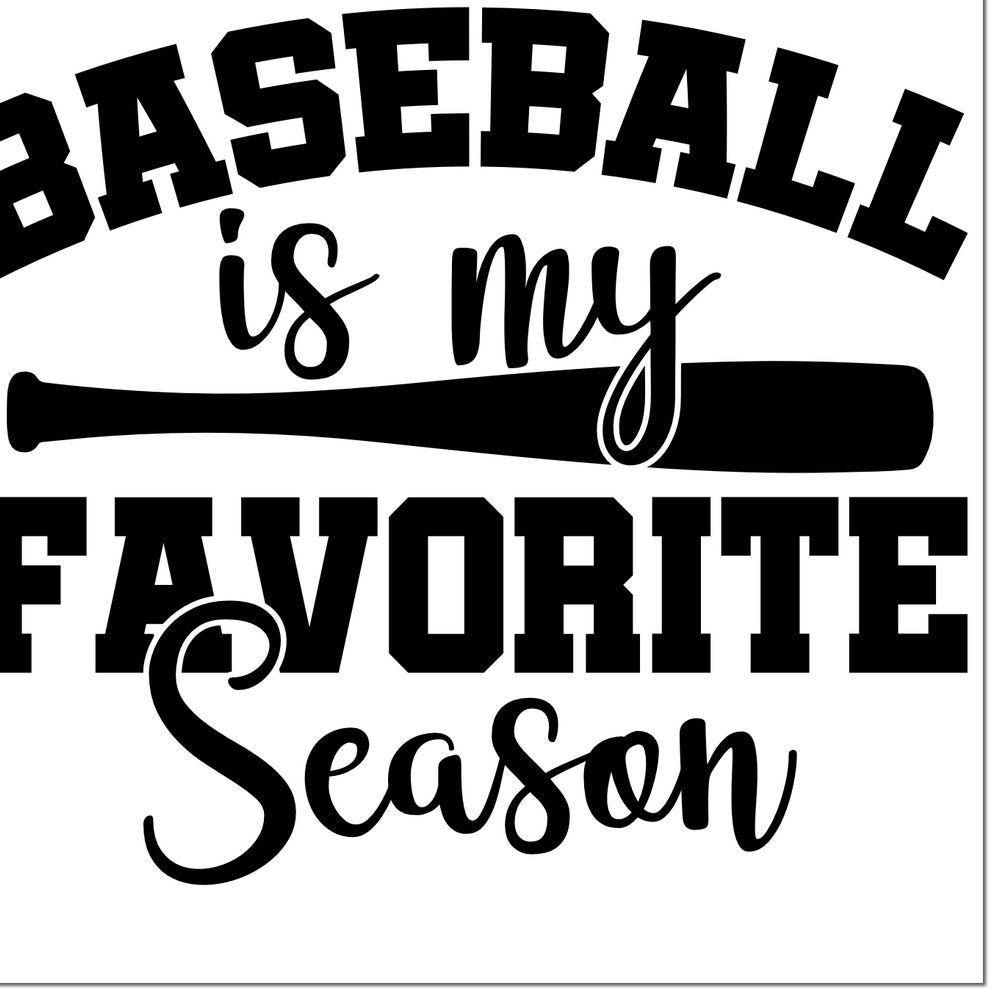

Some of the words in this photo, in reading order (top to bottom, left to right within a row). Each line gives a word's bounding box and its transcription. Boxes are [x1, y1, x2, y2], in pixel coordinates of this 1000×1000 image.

[219, 208, 379, 380] is
[452, 234, 721, 465] my
[143, 601, 797, 885] Season
